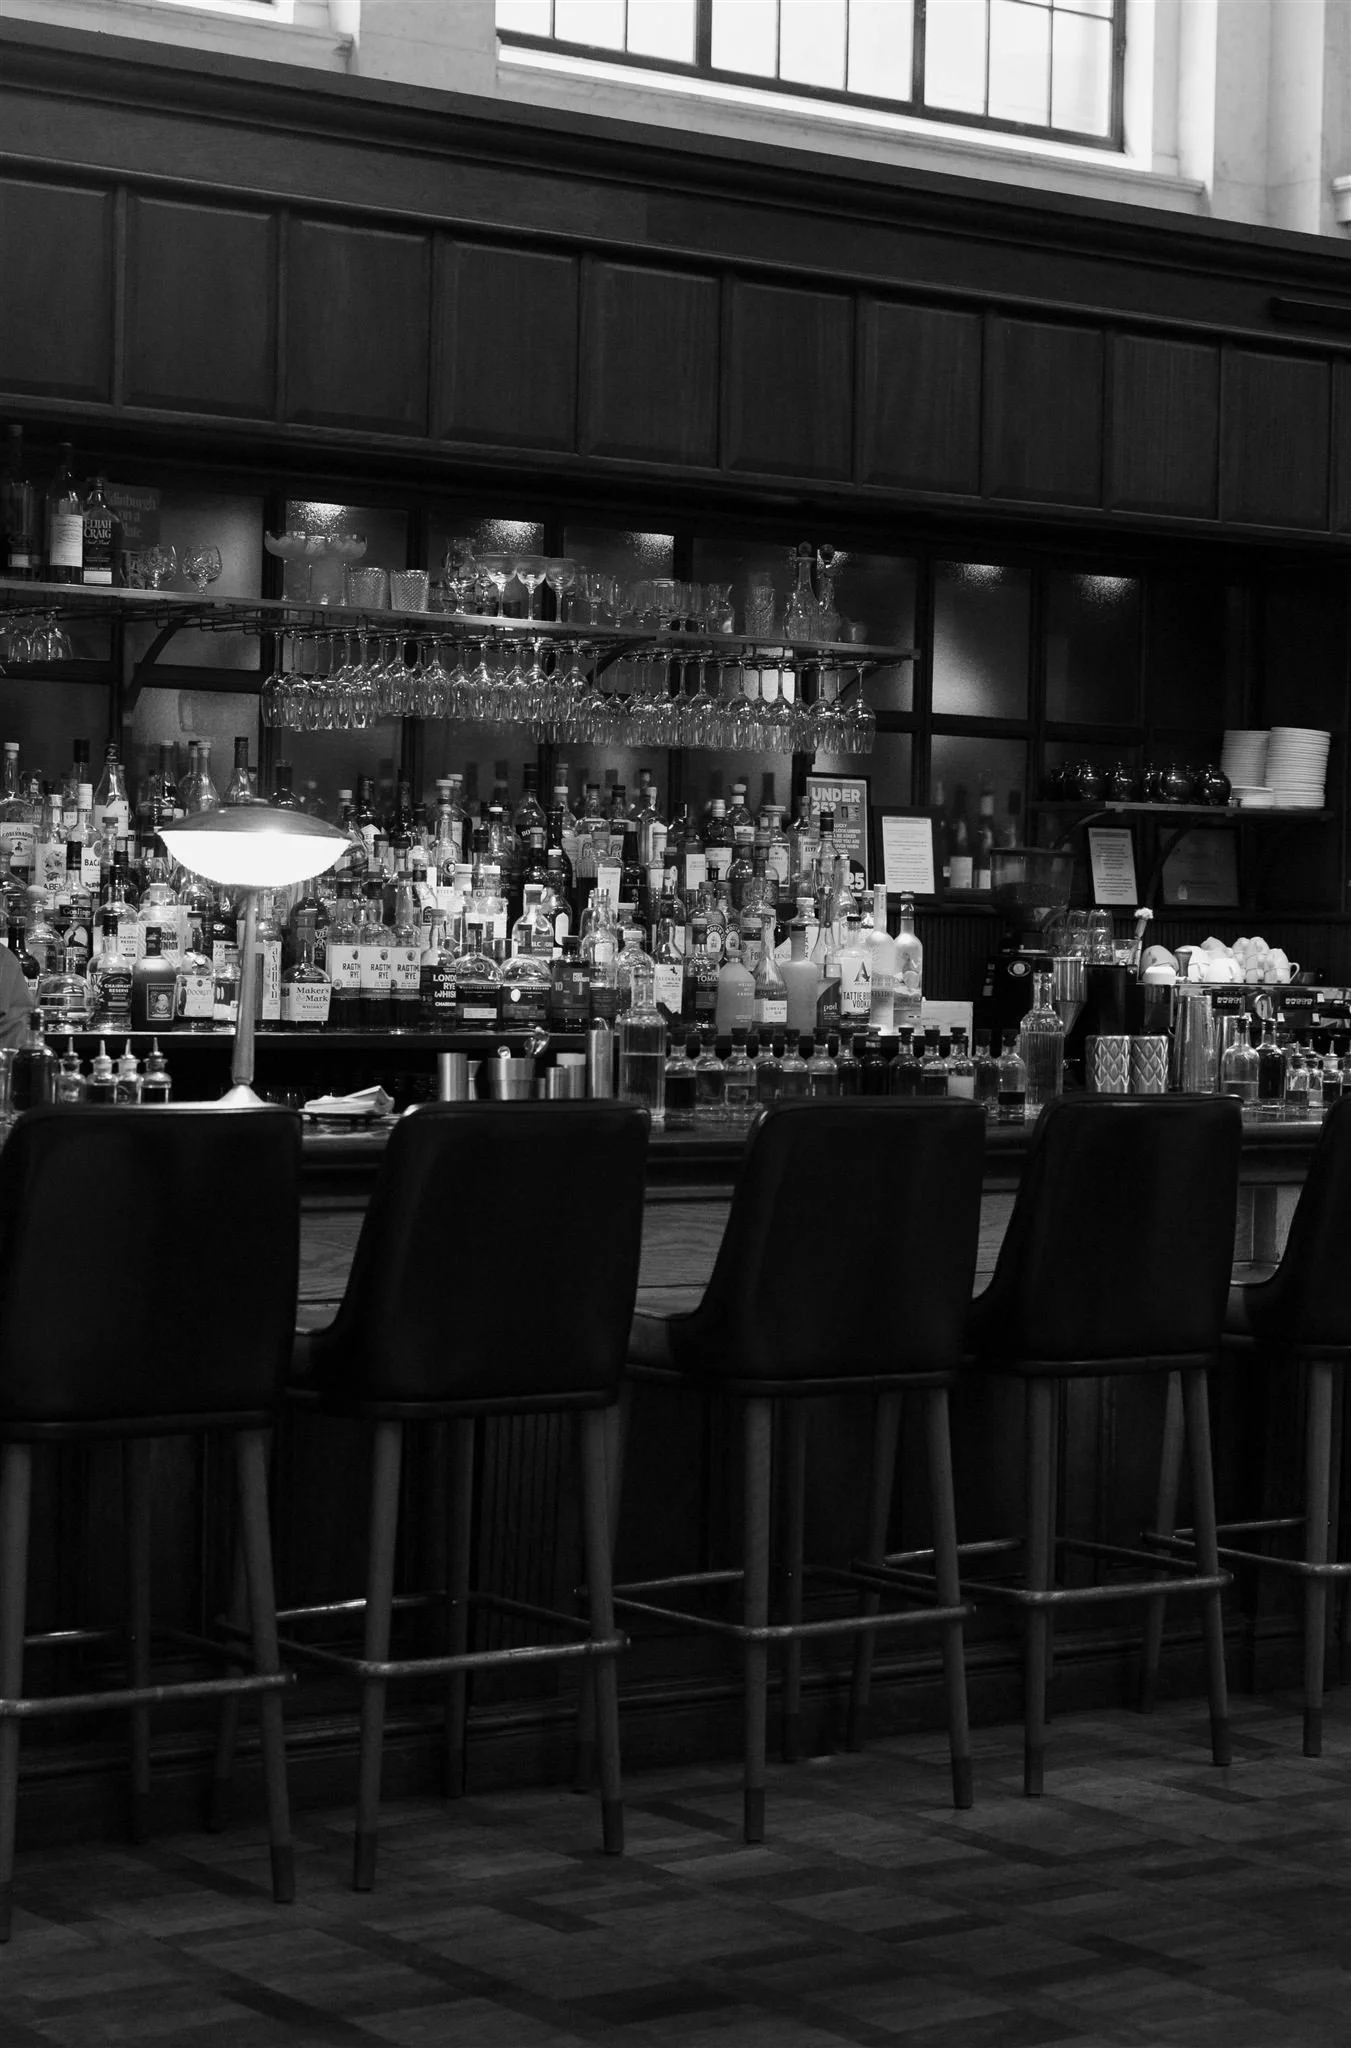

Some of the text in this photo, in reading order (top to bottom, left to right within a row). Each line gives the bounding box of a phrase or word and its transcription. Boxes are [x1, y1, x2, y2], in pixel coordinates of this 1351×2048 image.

[84, 519, 112, 529] ELIJAH
[83, 528, 112, 539] CRAIG
[811, 786, 860, 803] UNDER
[811, 800, 837, 815] 25?
[350, 971, 360, 979] RYE
[405, 972, 417, 980] RYE
[443, 982, 456, 990] RYE
[296, 987, 329, 995] Maker's
[305, 994, 328, 1002] Mark
